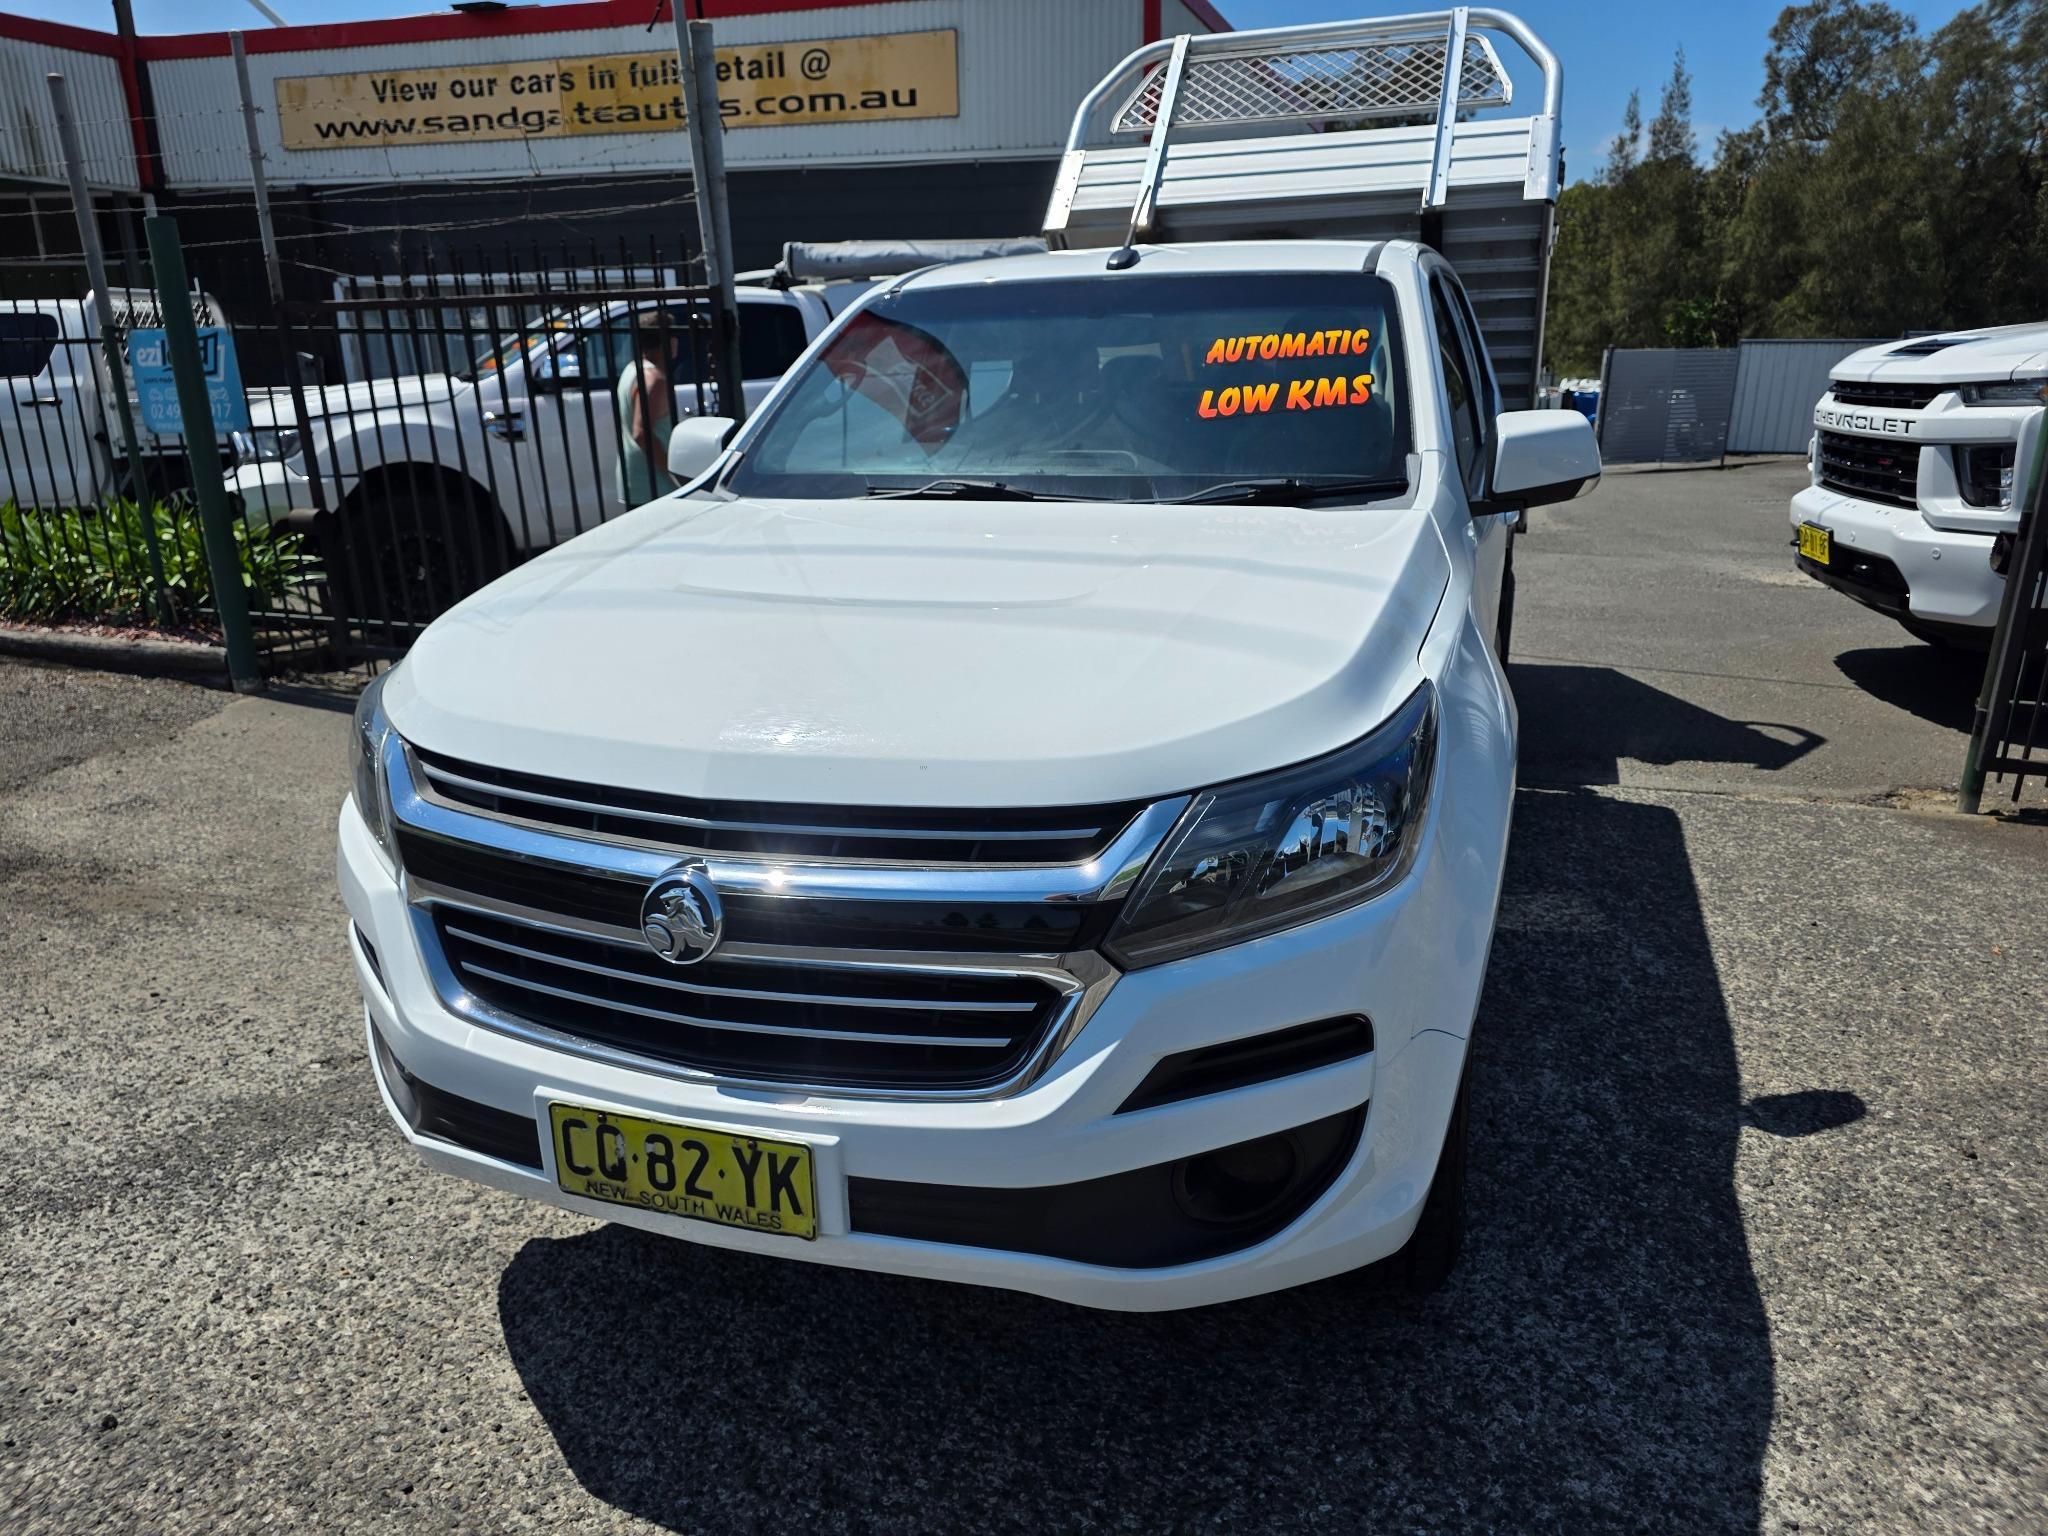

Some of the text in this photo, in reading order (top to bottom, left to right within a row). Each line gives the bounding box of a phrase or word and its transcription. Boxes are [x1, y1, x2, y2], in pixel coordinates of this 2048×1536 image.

[371, 48, 831, 103] View our cars in full etail @
[315, 88, 917, 139] www.sandgateauts.com.au
[1206, 328, 1370, 365] AUTOMATIC
[1198, 374, 1374, 419] LOW KMS
[1815, 409, 1917, 435] CHEVROLET
[585, 1179, 782, 1229] NEW SOUTH WALES
